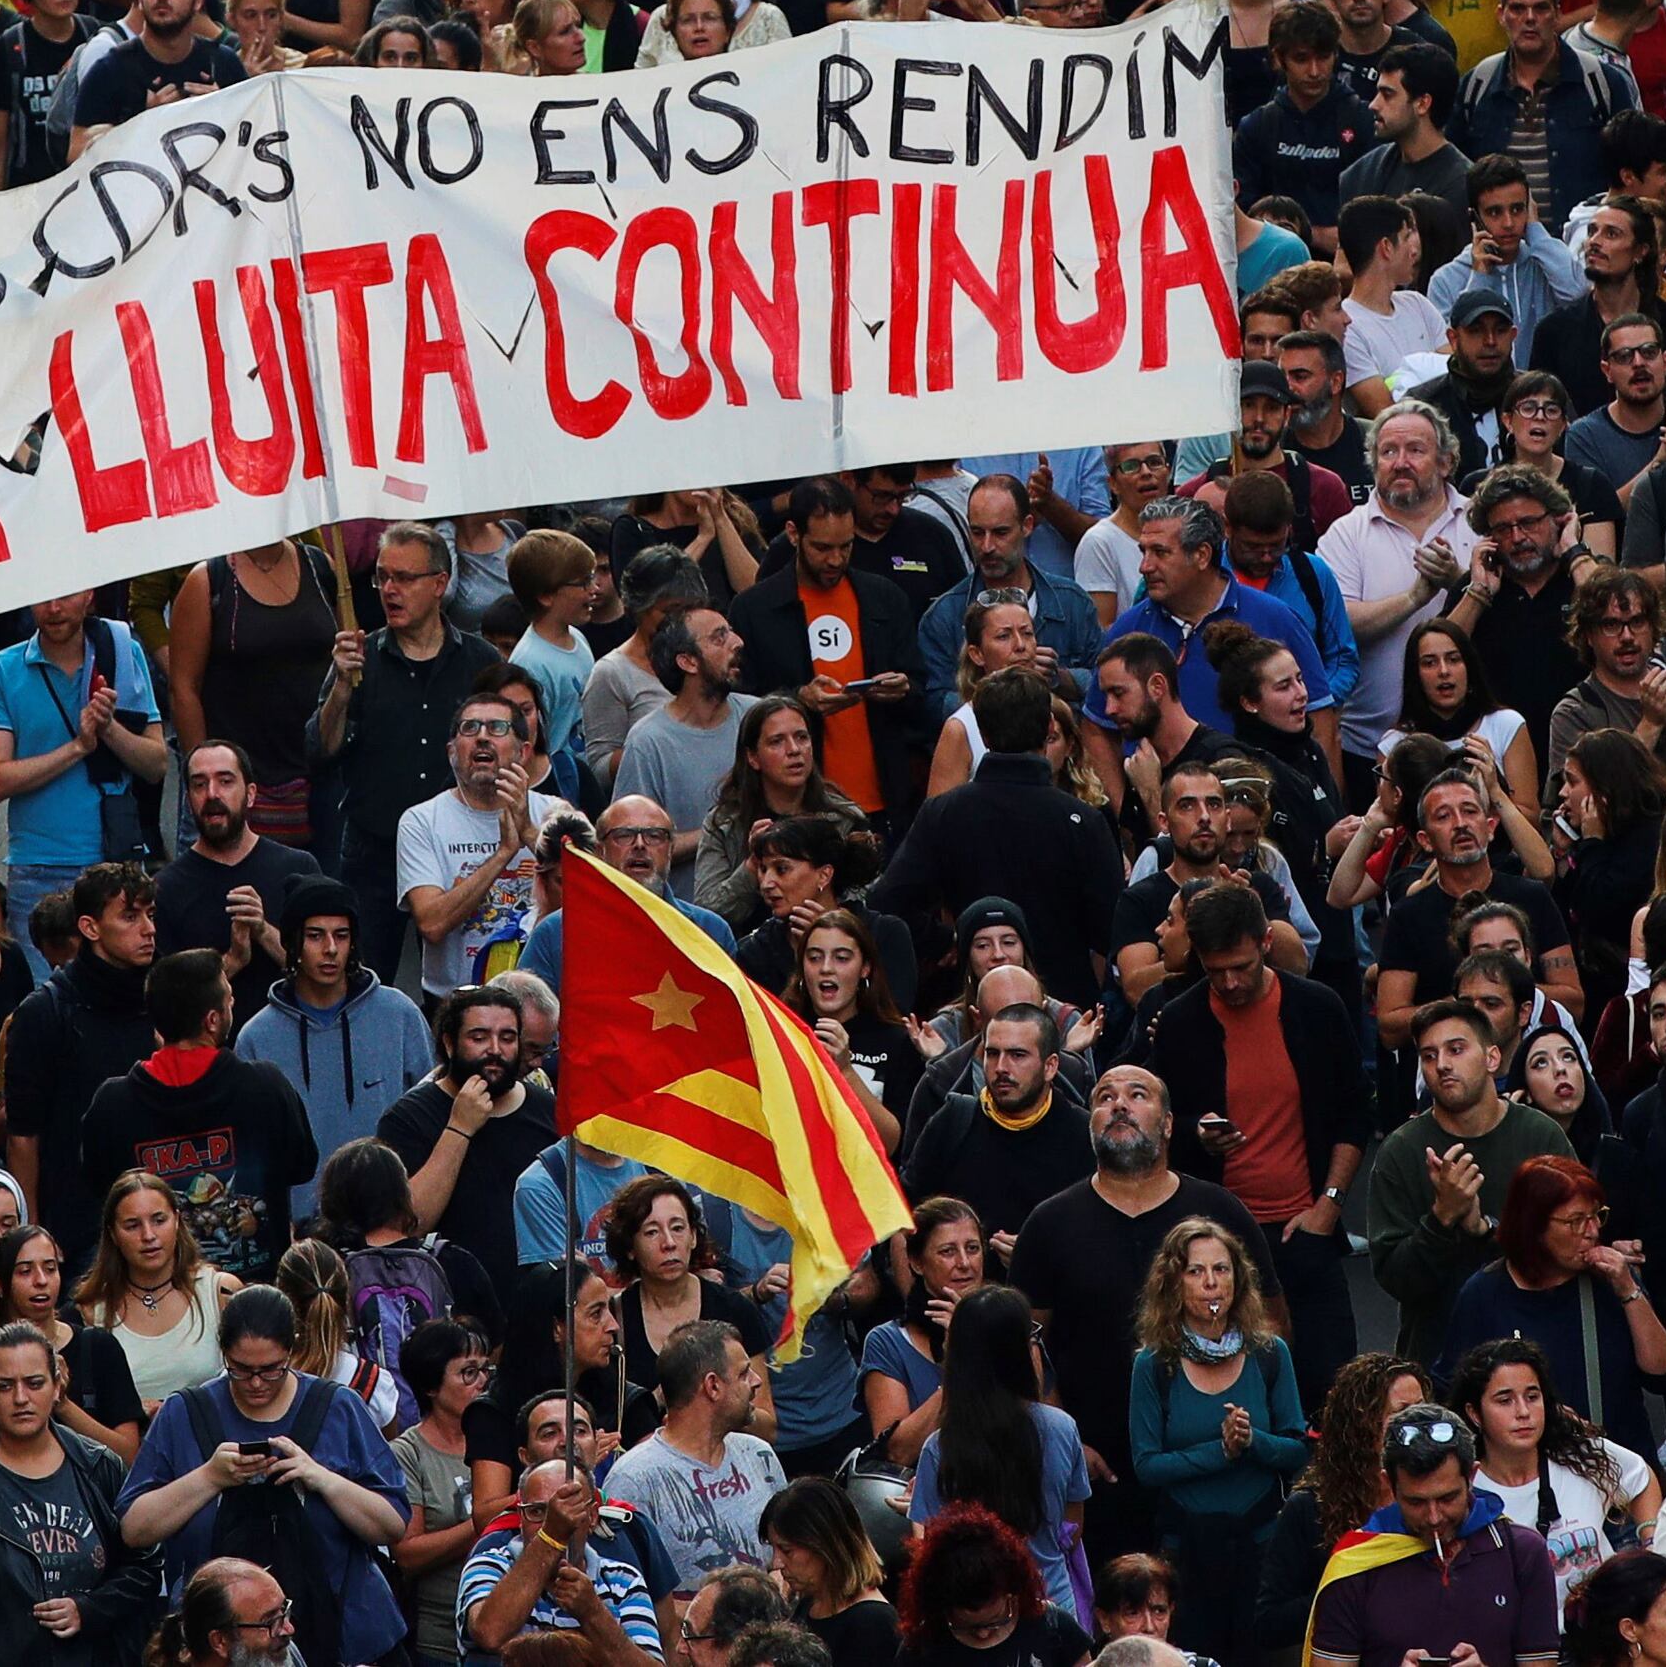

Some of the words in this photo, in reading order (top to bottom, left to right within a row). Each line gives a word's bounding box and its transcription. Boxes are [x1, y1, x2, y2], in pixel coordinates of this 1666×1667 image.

[351, 94, 484, 189] NO
[531, 70, 759, 186] ENS
[46, 233, 487, 533] LLUITA
[526, 146, 1242, 441] CONTINUA
[818, 627, 839, 647] Sí
[142, 1135, 229, 1174] SKA-P
[693, 1462, 751, 1501] fresh
[27, 1528, 79, 1555] EVER
